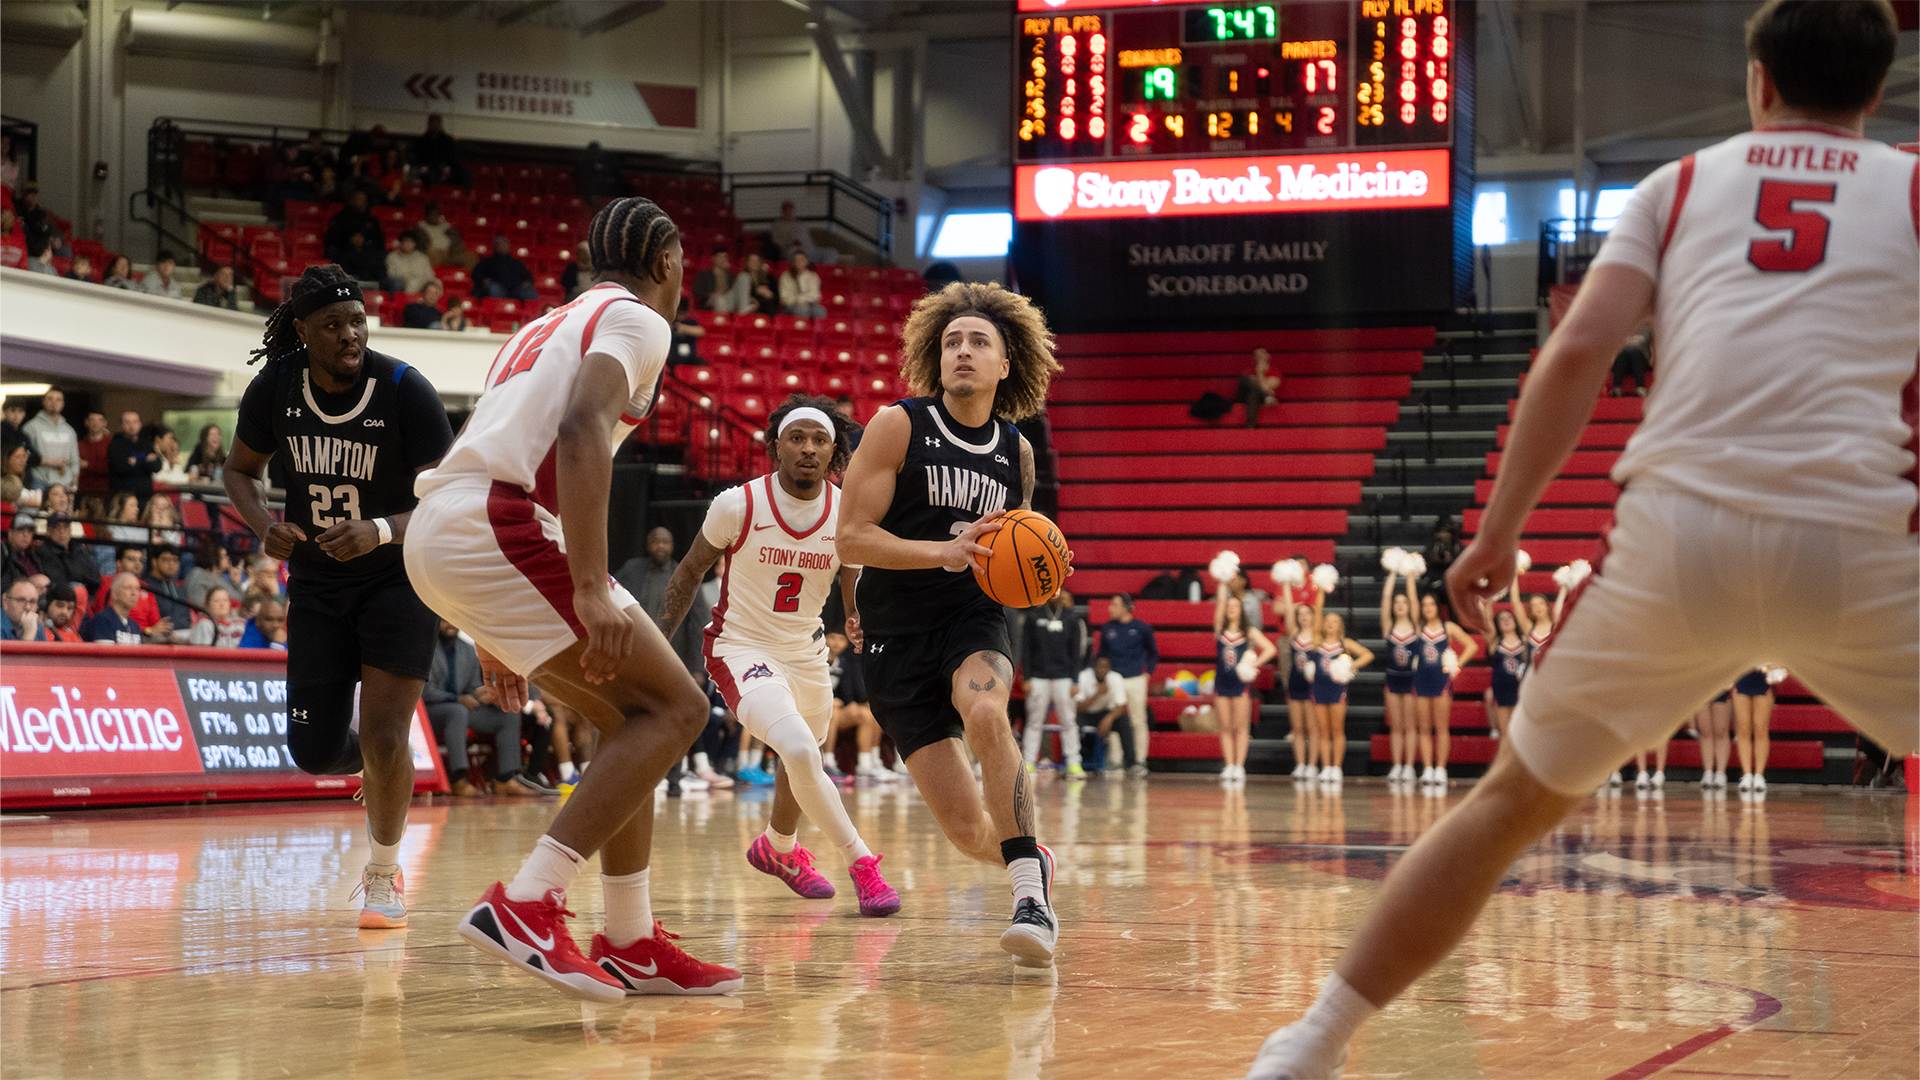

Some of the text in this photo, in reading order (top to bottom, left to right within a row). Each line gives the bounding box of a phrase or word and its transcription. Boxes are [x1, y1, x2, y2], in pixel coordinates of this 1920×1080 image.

[1207, 6, 1276, 39] 7:47
[1401, 17, 1417, 38] 0
[1433, 15, 1448, 36] 0
[1373, 36, 1448, 60] 3 0 0
[1031, 56, 1047, 77] 5
[1305, 59, 1337, 92] 17
[1369, 61, 1385, 82] 5
[477, 71, 593, 97] CONCESSIONS
[1065, 78, 1076, 96] 1
[1089, 75, 1105, 96] 5
[1144, 66, 1175, 99] 19
[1229, 70, 1239, 92] 1
[1357, 82, 1385, 104] 23
[1400, 80, 1416, 102] 0
[1432, 78, 1448, 101] 0
[477, 93, 574, 116] RESTROOMS
[1089, 95, 1105, 116] 2
[1357, 101, 1447, 126] 25 0 0
[1130, 114, 1150, 143] 2
[1165, 114, 1184, 138] 4
[1207, 111, 1259, 138] 12 1
[1275, 112, 1292, 133] 4
[1316, 106, 1336, 135] 2
[1746, 144, 1859, 173] BUTLER
[1076, 161, 1429, 214] Stony Brook Medicine
[1747, 177, 1837, 272] 5
[1128, 240, 1329, 266] SHAROFF FAMILY
[1147, 273, 1309, 297] SCOREBOARD
[491, 313, 568, 390] 12
[363, 418, 385, 428] CAA
[286, 435, 379, 481] HAMPTON
[994, 454, 1009, 467] CAA
[924, 464, 1008, 516] HAMPTON
[308, 484, 362, 529] 23
[759, 546, 834, 570] STONY BROOK
[1031, 553, 1053, 597] NCAA
[772, 572, 804, 613] 2
[187, 678, 227, 703] FG%
[228, 680, 259, 703] 46.7
[199, 711, 239, 736] FT%
[244, 712, 271, 736] 0.0
[201, 744, 248, 769] 3PT%
[246, 745, 281, 769] 60.0
